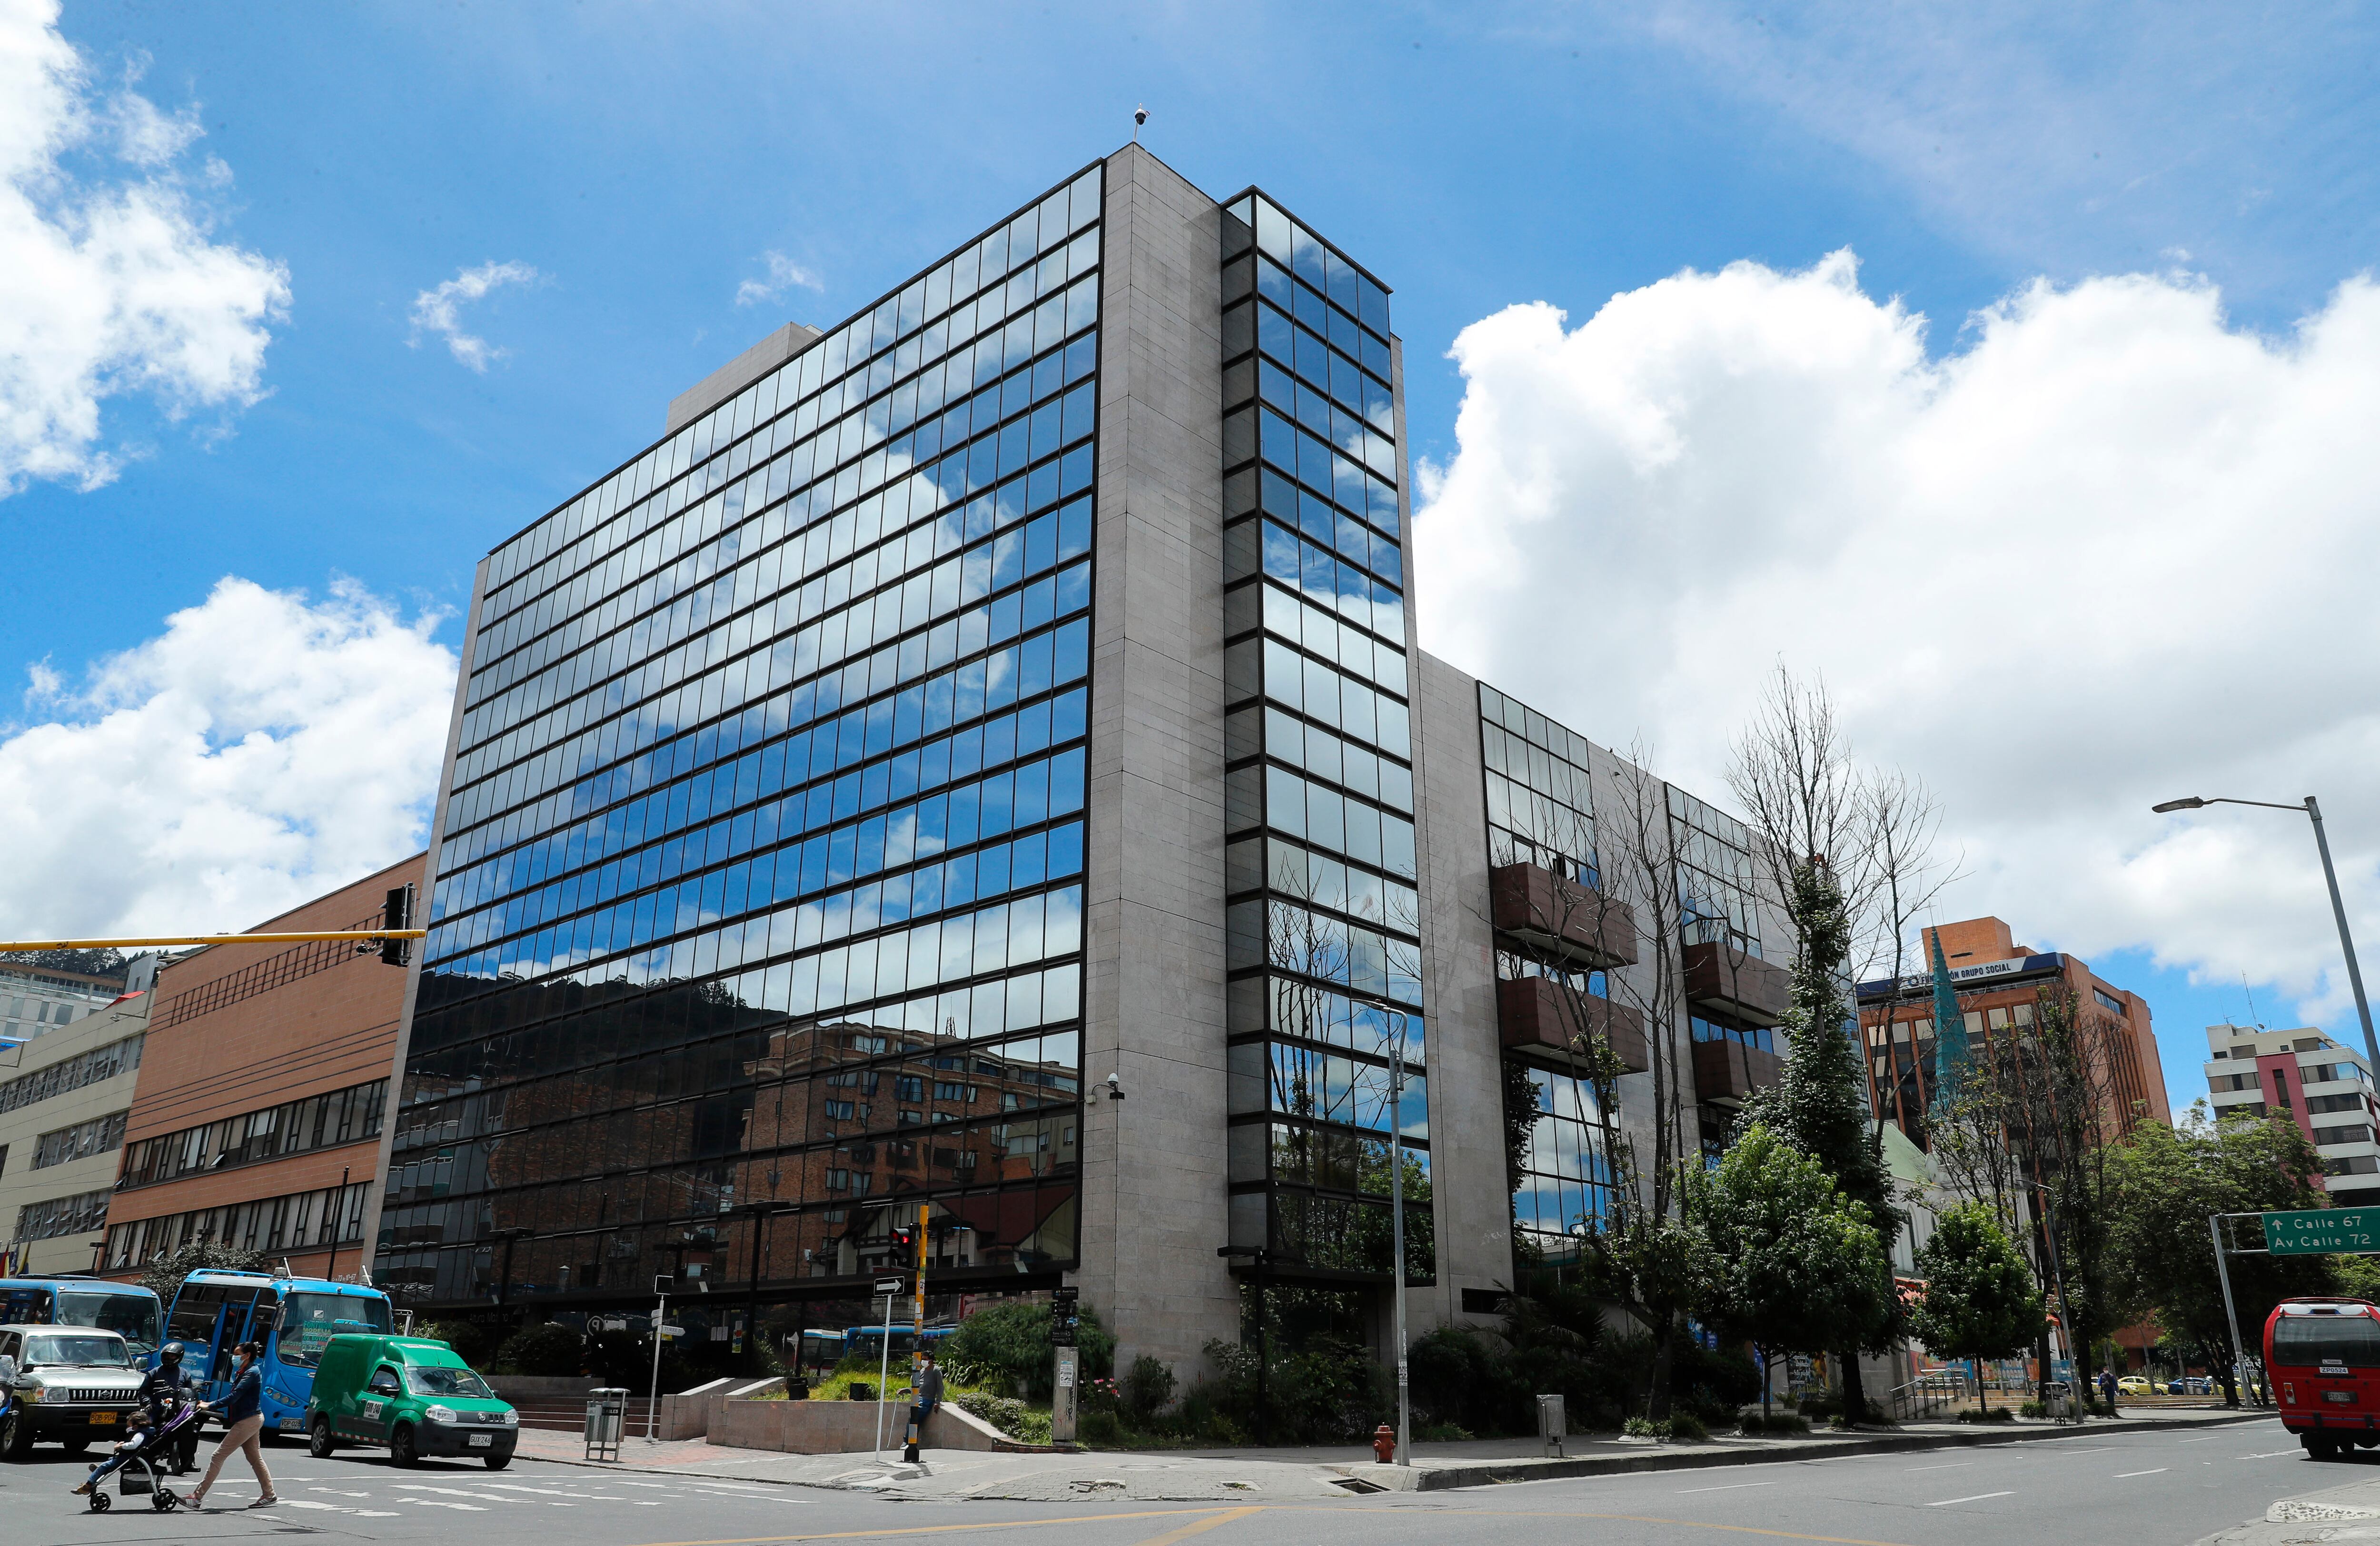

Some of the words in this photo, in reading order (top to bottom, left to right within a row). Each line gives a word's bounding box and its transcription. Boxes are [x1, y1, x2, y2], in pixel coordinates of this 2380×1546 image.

[1921, 970, 1959, 983] FUNÓN
[1961, 967, 1983, 977] GRUPO
[1986, 963, 2011, 974] SOCIAL
[2294, 1219, 2334, 1229] Calle
[2343, 1216, 2361, 1227] 67
[2275, 1237, 2293, 1247] Av
[2301, 1237, 2341, 1247] Calle
[2349, 1234, 2371, 1244] 72
